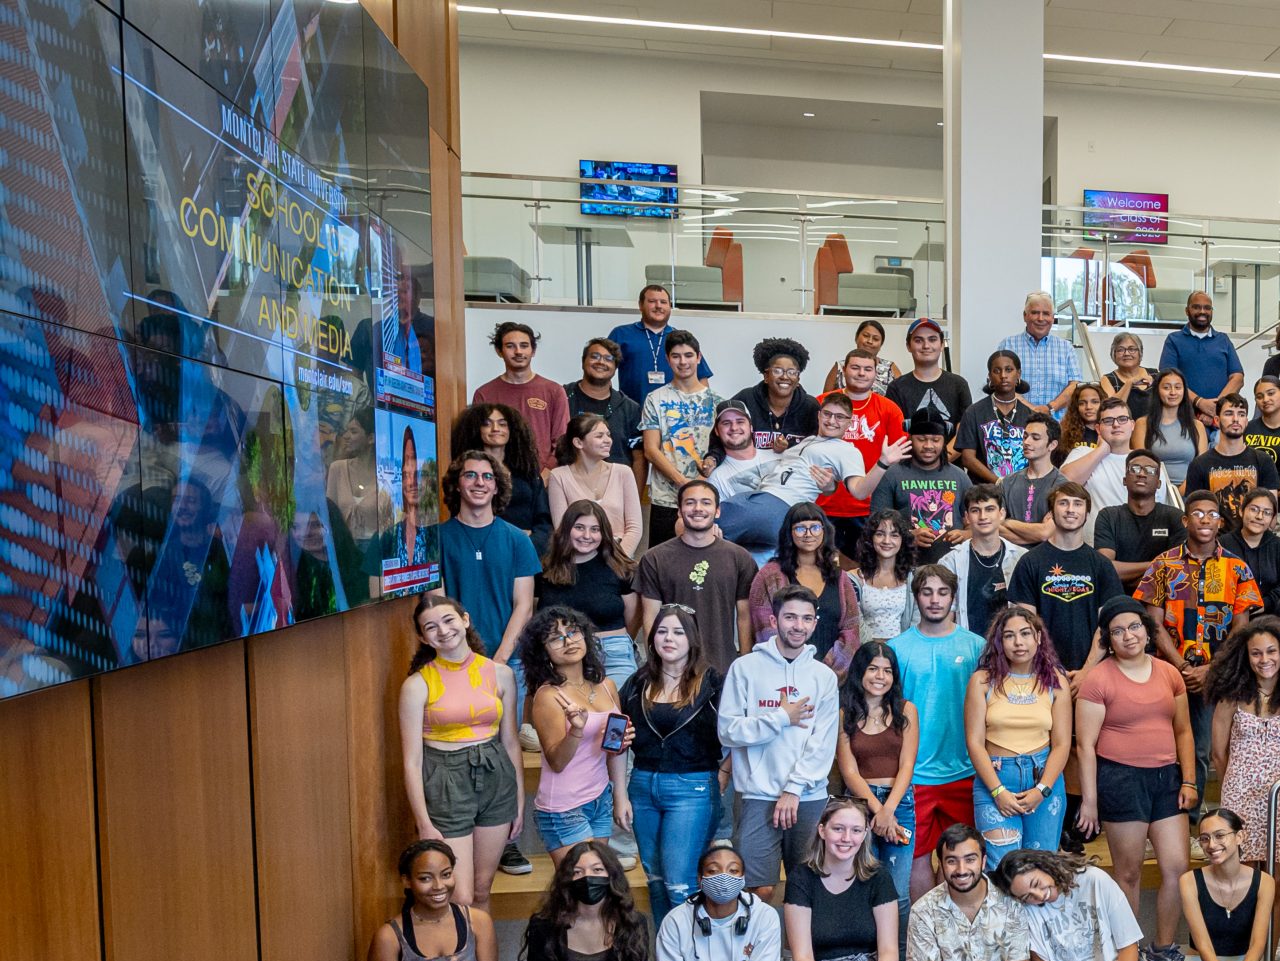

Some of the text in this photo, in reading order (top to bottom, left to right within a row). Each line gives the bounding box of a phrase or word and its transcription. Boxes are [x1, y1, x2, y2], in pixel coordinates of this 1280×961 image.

[221, 104, 348, 216] MONTCLAIR STATE UNIVERSITY
[246, 173, 326, 250] SCHOOL
[1107, 196, 1161, 210] Welcome
[179, 197, 351, 312] COMMUNICATION
[257, 295, 353, 361] AND MEDIA
[901, 480, 957, 491] HAWKEYE
